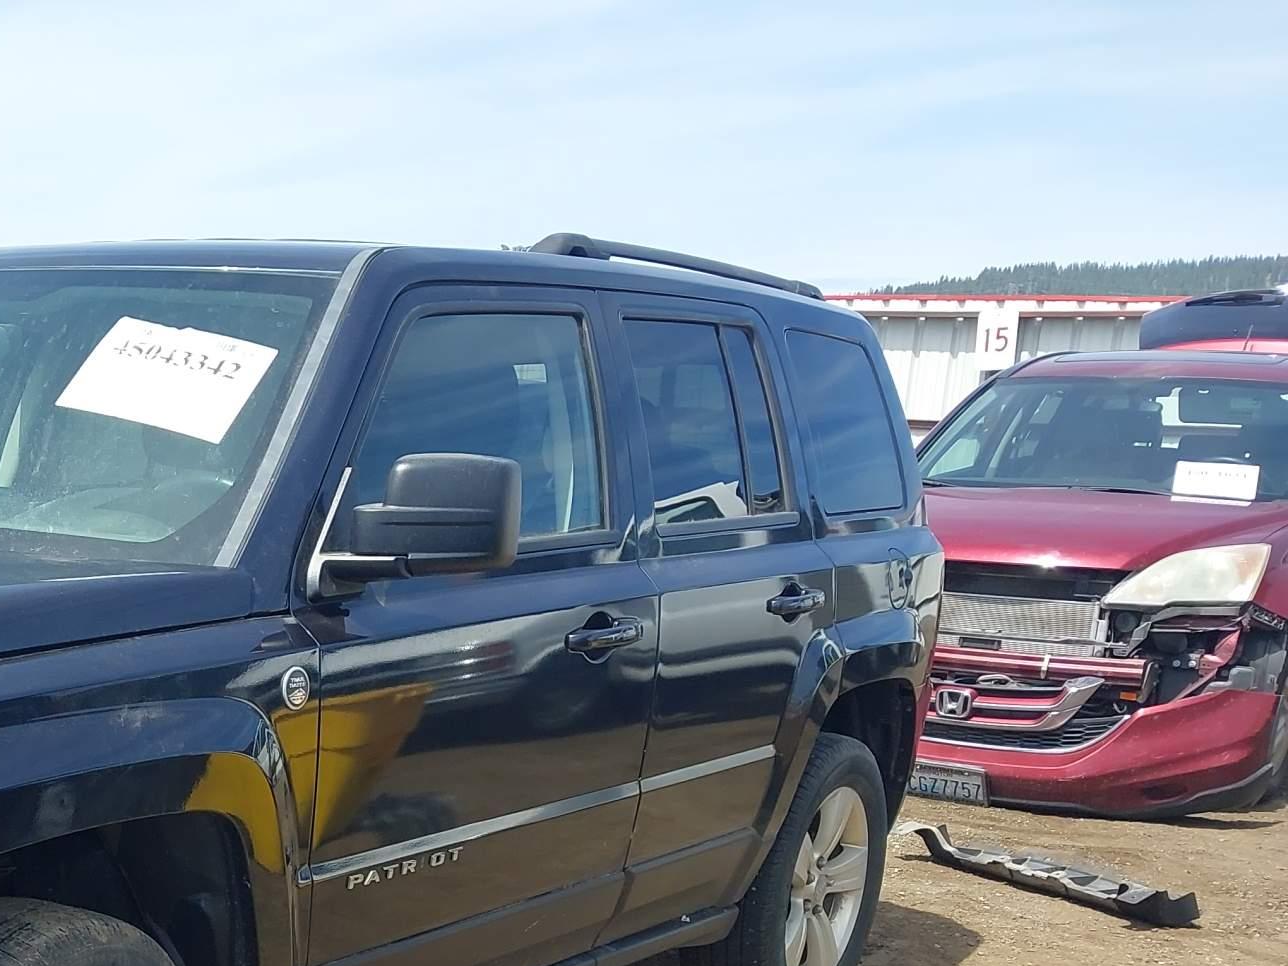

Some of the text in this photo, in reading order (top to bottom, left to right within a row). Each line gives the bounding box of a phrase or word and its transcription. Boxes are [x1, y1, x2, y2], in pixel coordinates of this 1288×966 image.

[984, 326, 1009, 353] 15
[114, 339, 242, 380] 45043342
[908, 774, 981, 801] CGZ7757
